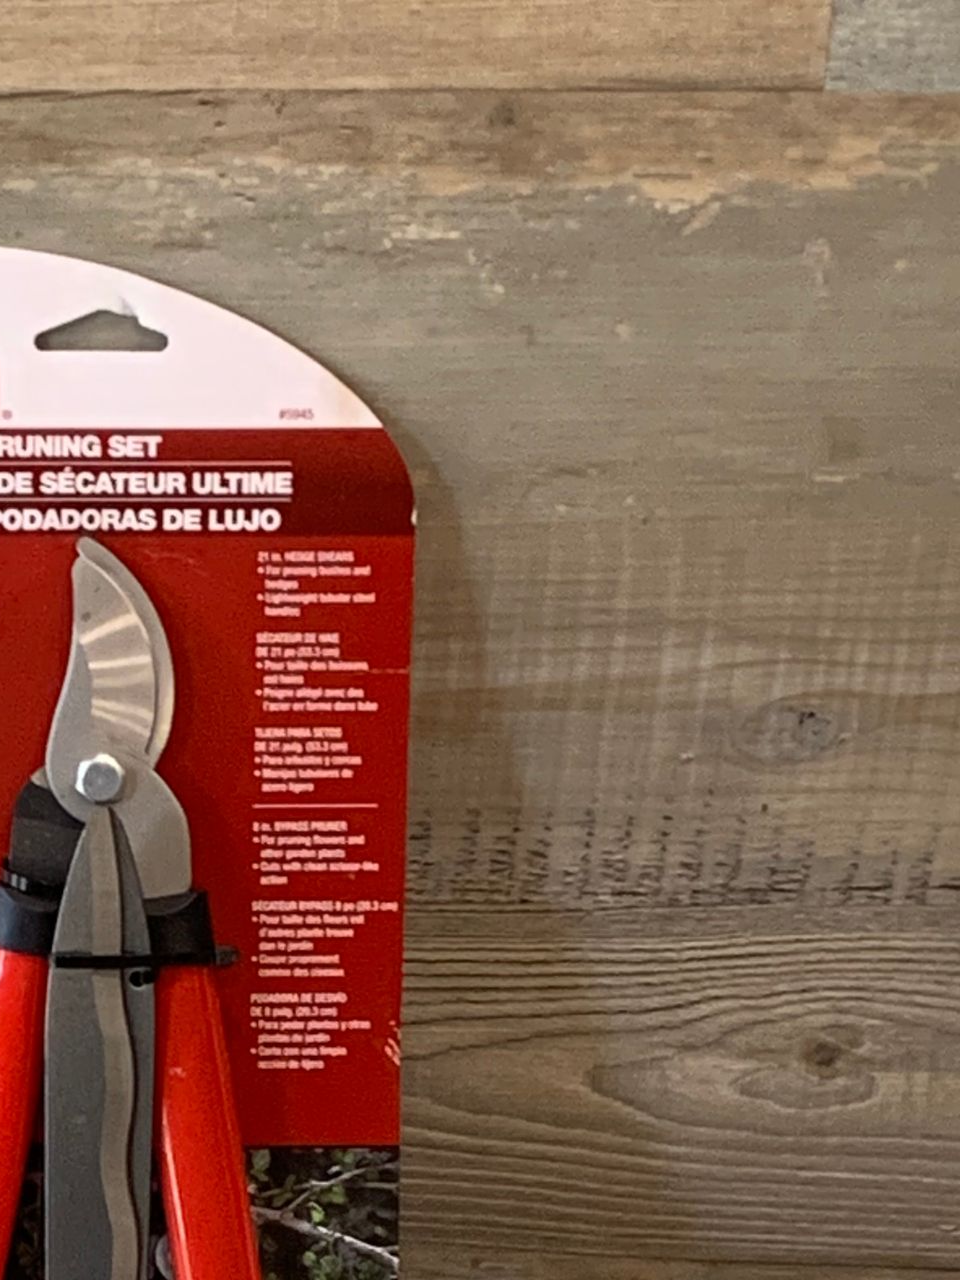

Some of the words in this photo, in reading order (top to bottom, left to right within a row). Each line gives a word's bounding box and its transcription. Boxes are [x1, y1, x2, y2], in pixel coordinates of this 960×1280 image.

[107, 435, 163, 458] SET
[39, 466, 186, 495] SÉCATEUR
[192, 472, 294, 495] ULTIME
[162, 508, 202, 531] DE
[208, 508, 282, 531] LUJO
